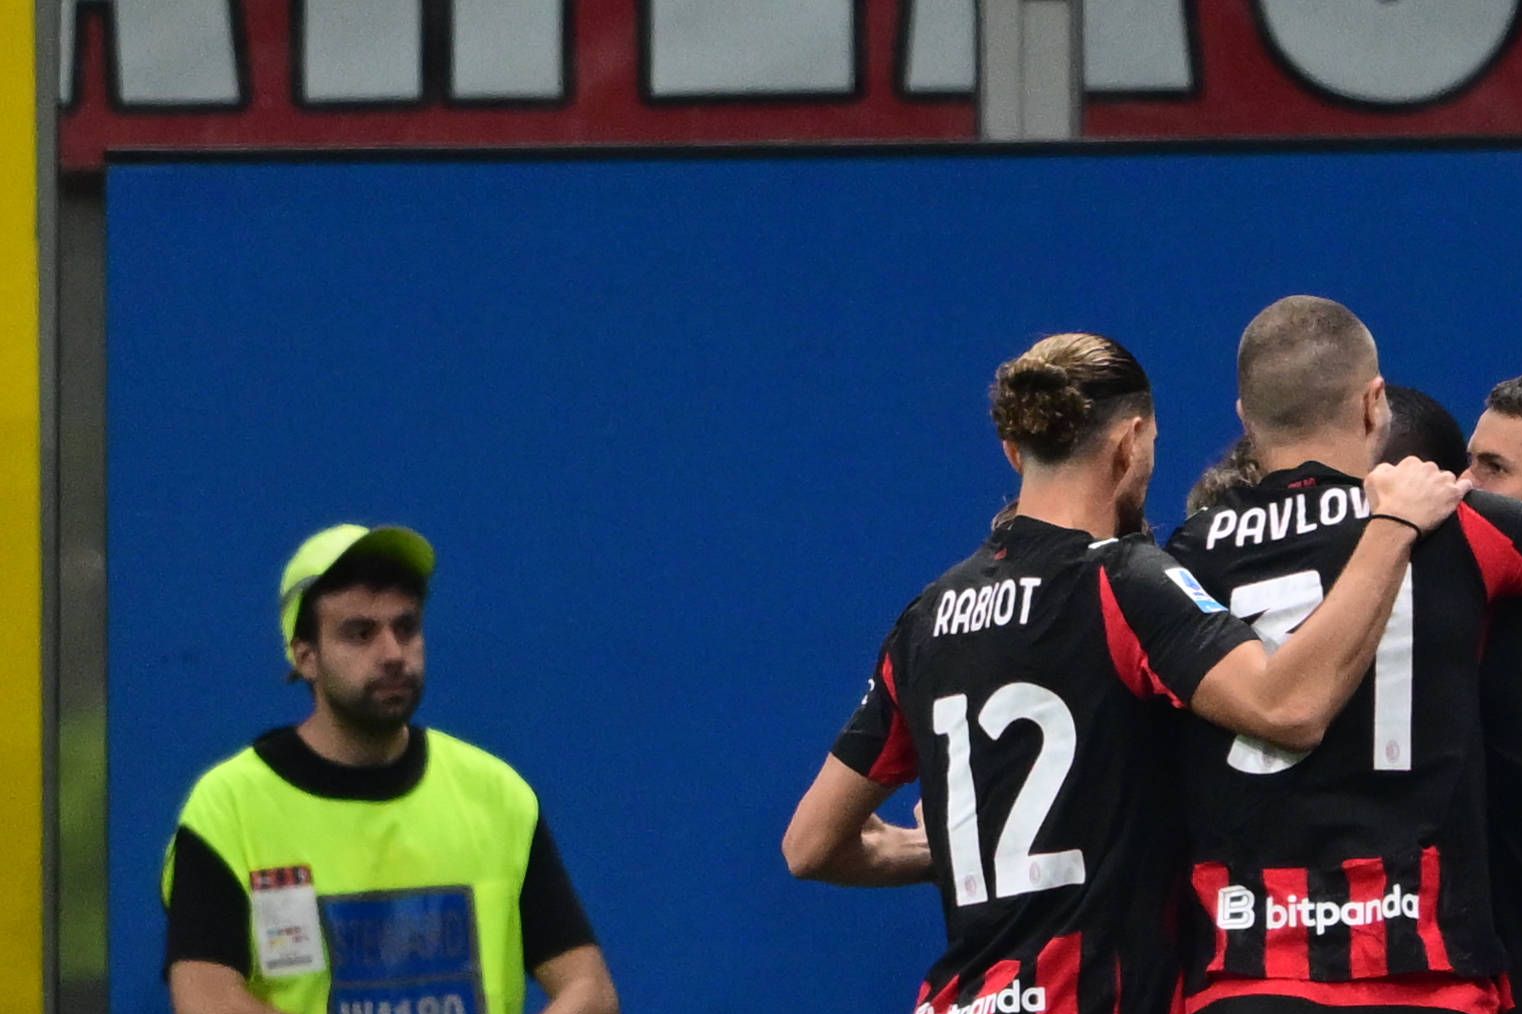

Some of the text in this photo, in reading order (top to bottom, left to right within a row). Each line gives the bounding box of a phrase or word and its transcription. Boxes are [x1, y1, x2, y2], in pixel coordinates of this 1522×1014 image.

[933, 577, 1042, 638] RABIOT
[932, 682, 1086, 907] 12
[1266, 883, 1420, 936] bitpanda
